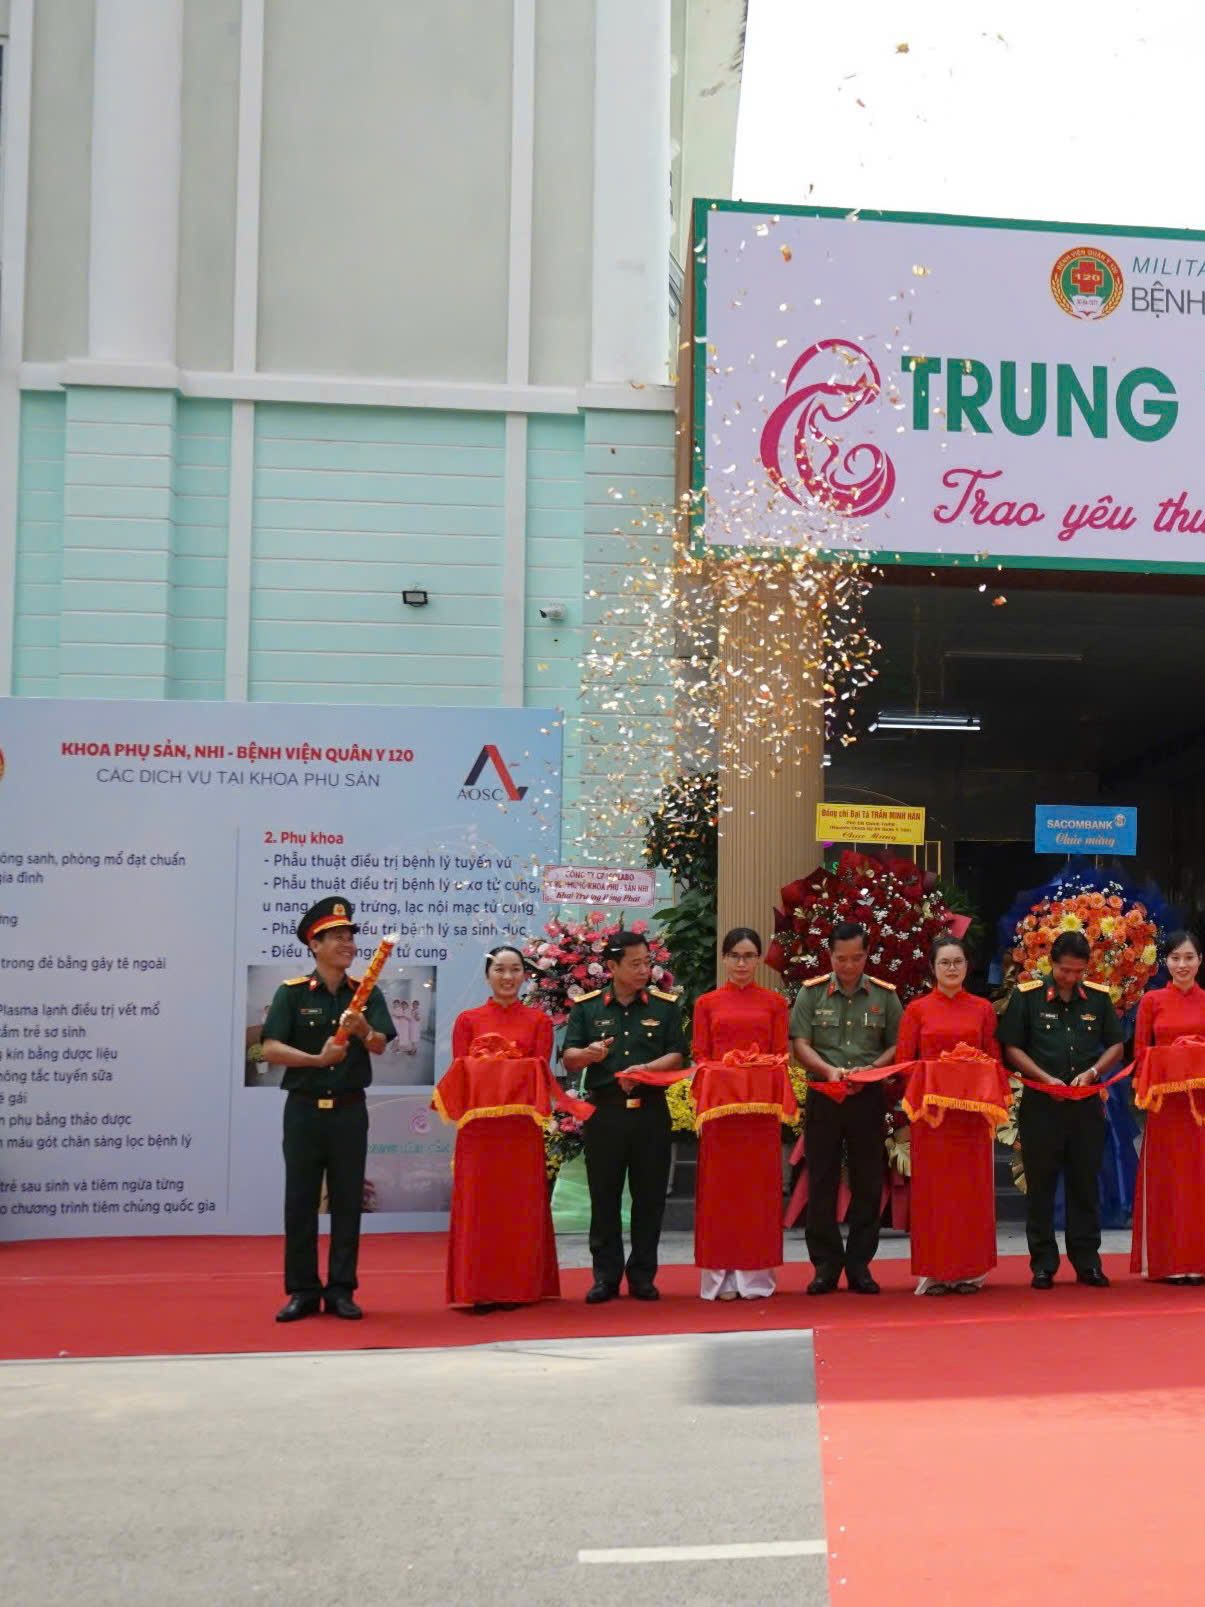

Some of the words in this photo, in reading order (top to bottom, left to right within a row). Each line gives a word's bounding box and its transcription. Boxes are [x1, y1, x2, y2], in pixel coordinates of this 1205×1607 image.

[1075, 273, 1101, 281] 120
[1131, 280, 1205, 318] BỆNH
[901, 354, 1179, 443] TRUNG
[933, 468, 1046, 528] Trao
[1057, 495, 1137, 543] yêu
[61, 742, 111, 757] KHOA
[115, 743, 150, 762] PHỤ
[153, 738, 191, 760] SẢN,
[194, 745, 225, 759] NHI
[236, 741, 282, 764] BỆNH
[285, 742, 322, 765] VIỆN
[325, 743, 372, 763] QUÂN
[375, 749, 386, 762] Y
[387, 749, 415, 763] 120
[249, 772, 299, 787] KHOA
[344, 770, 381, 788] SẢN
[457, 788, 504, 801] AOSC
[1046, 819, 1113, 830] SACOMBANK
[264, 832, 277, 844] 2.
[281, 832, 307, 847] Phụ
[310, 832, 345, 845] khoa
[127, 853, 147, 869] đạt
[273, 852, 308, 868] Phẫu
[311, 855, 347, 871] thuật
[350, 853, 380, 868] điều
[383, 855, 399, 871] trị
[402, 855, 436, 871] bệnh
[439, 855, 451, 871] lý
[495, 856, 512, 869] vú
[272, 874, 307, 891] Phẫu
[310, 877, 347, 893] thuật
[350, 876, 380, 891] điều
[383, 878, 399, 894] trị
[402, 878, 436, 894] bệnh
[439, 878, 450, 891] lý
[262, 902, 272, 913] u
[275, 902, 309, 917] nang
[404, 900, 425, 916] lạc
[428, 899, 449, 917] nội
[452, 902, 482, 917] mạc
[271, 920, 298, 935] Phẫ
[438, 922, 450, 938] lý
[453, 925, 468, 936] sa
[471, 923, 498, 936] sinh
[271, 944, 303, 958] Điều
[414, 946, 448, 960] cung
[42, 1003, 68, 1019] lạnh
[61, 1025, 87, 1038] sinh
[96, 1047, 118, 1063] liệu
[70, 1111, 99, 1127] thảo
[126, 1134, 145, 1149] lọc
[147, 1133, 178, 1149] bệnh
[181, 1133, 193, 1149] lý
[20, 1182, 42, 1193] sau
[45, 1179, 70, 1193] sinh
[163, 1197, 195, 1216] quốc
[197, 1199, 217, 1214] gia
